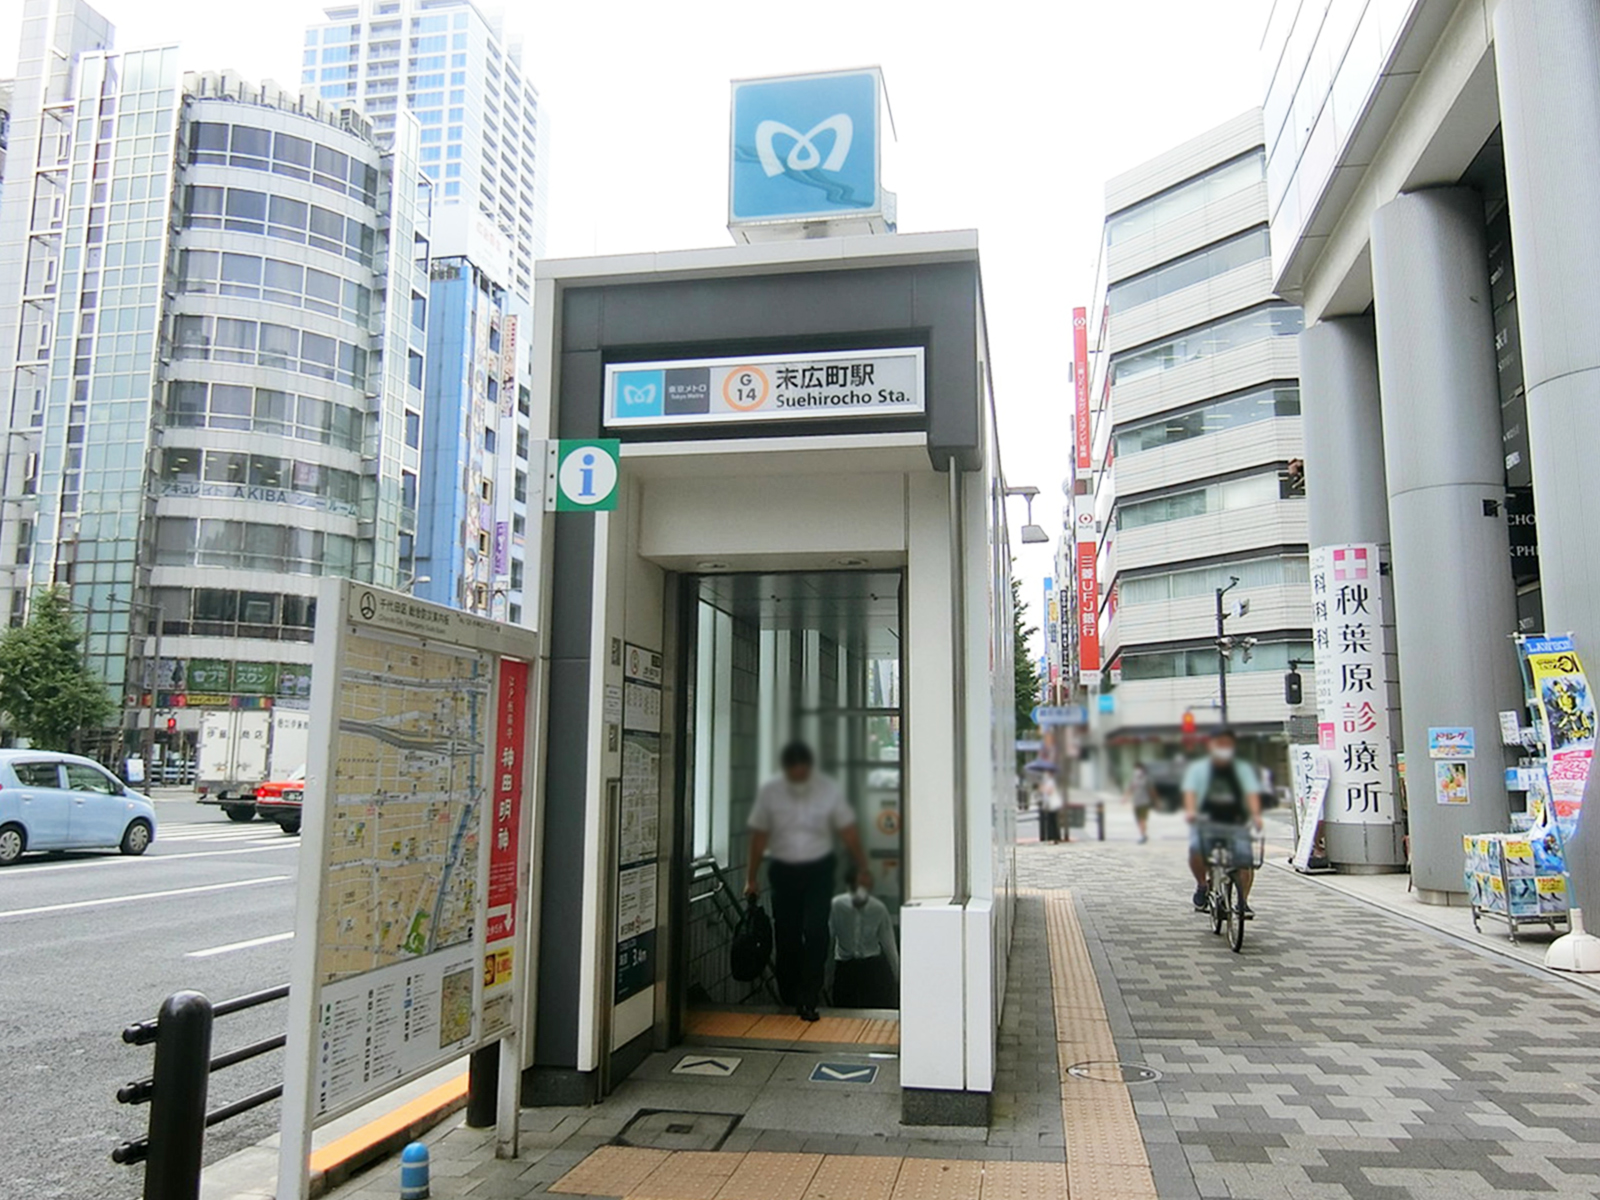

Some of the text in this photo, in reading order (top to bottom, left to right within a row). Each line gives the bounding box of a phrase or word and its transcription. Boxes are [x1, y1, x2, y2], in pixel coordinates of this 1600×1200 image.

[740, 373, 752, 386] G
[775, 363, 875, 389] 末広町駅
[737, 388, 756, 401] 14
[776, 389, 910, 408] Suehirocho Sta.
[233, 486, 288, 503] AKIBA
[1081, 555, 1095, 637] 三菱UFJ銀行
[1335, 583, 1383, 814] 秋葉原診療所
[498, 746, 515, 852] 神田明神
